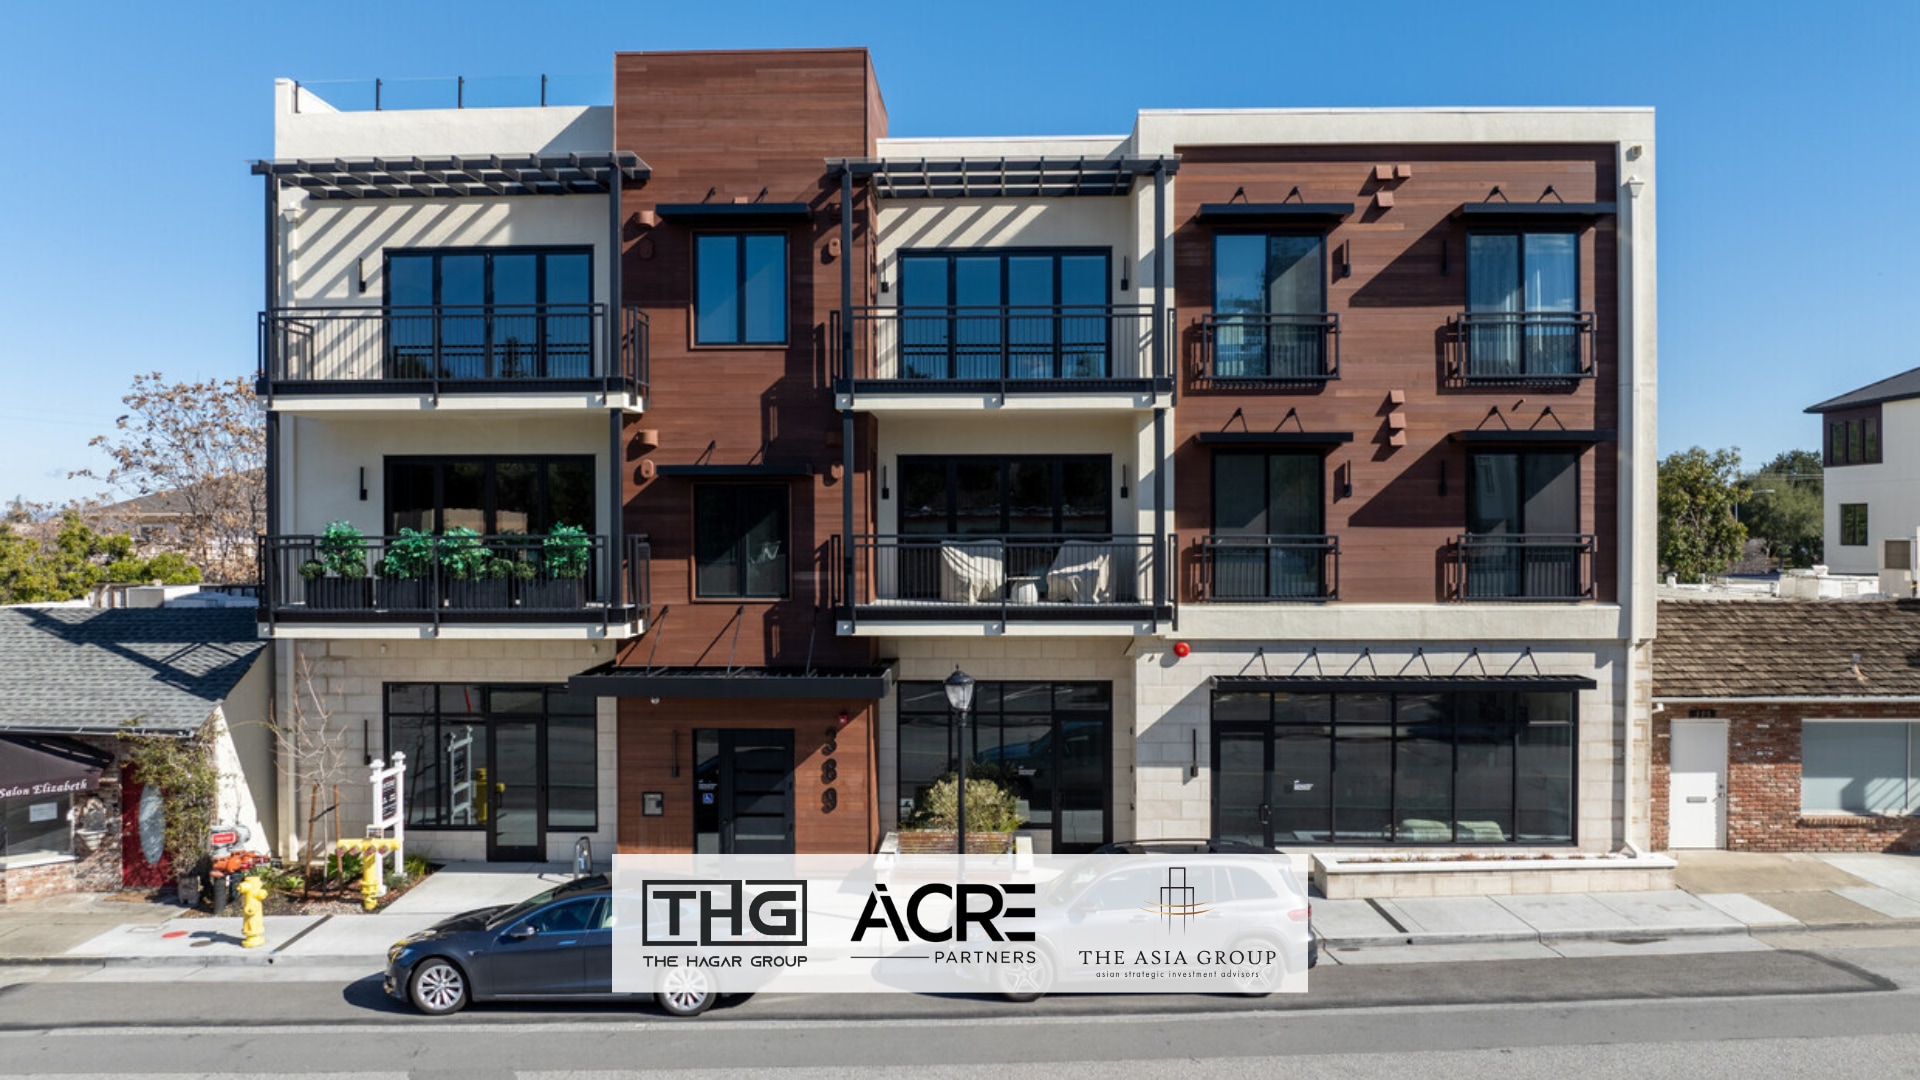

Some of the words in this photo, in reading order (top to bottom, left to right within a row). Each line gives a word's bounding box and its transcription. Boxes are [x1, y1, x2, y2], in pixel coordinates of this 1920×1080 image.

[0, 786, 30, 798] Salon
[32, 779, 88, 794] Elizabeth
[821, 726, 837, 814] 389
